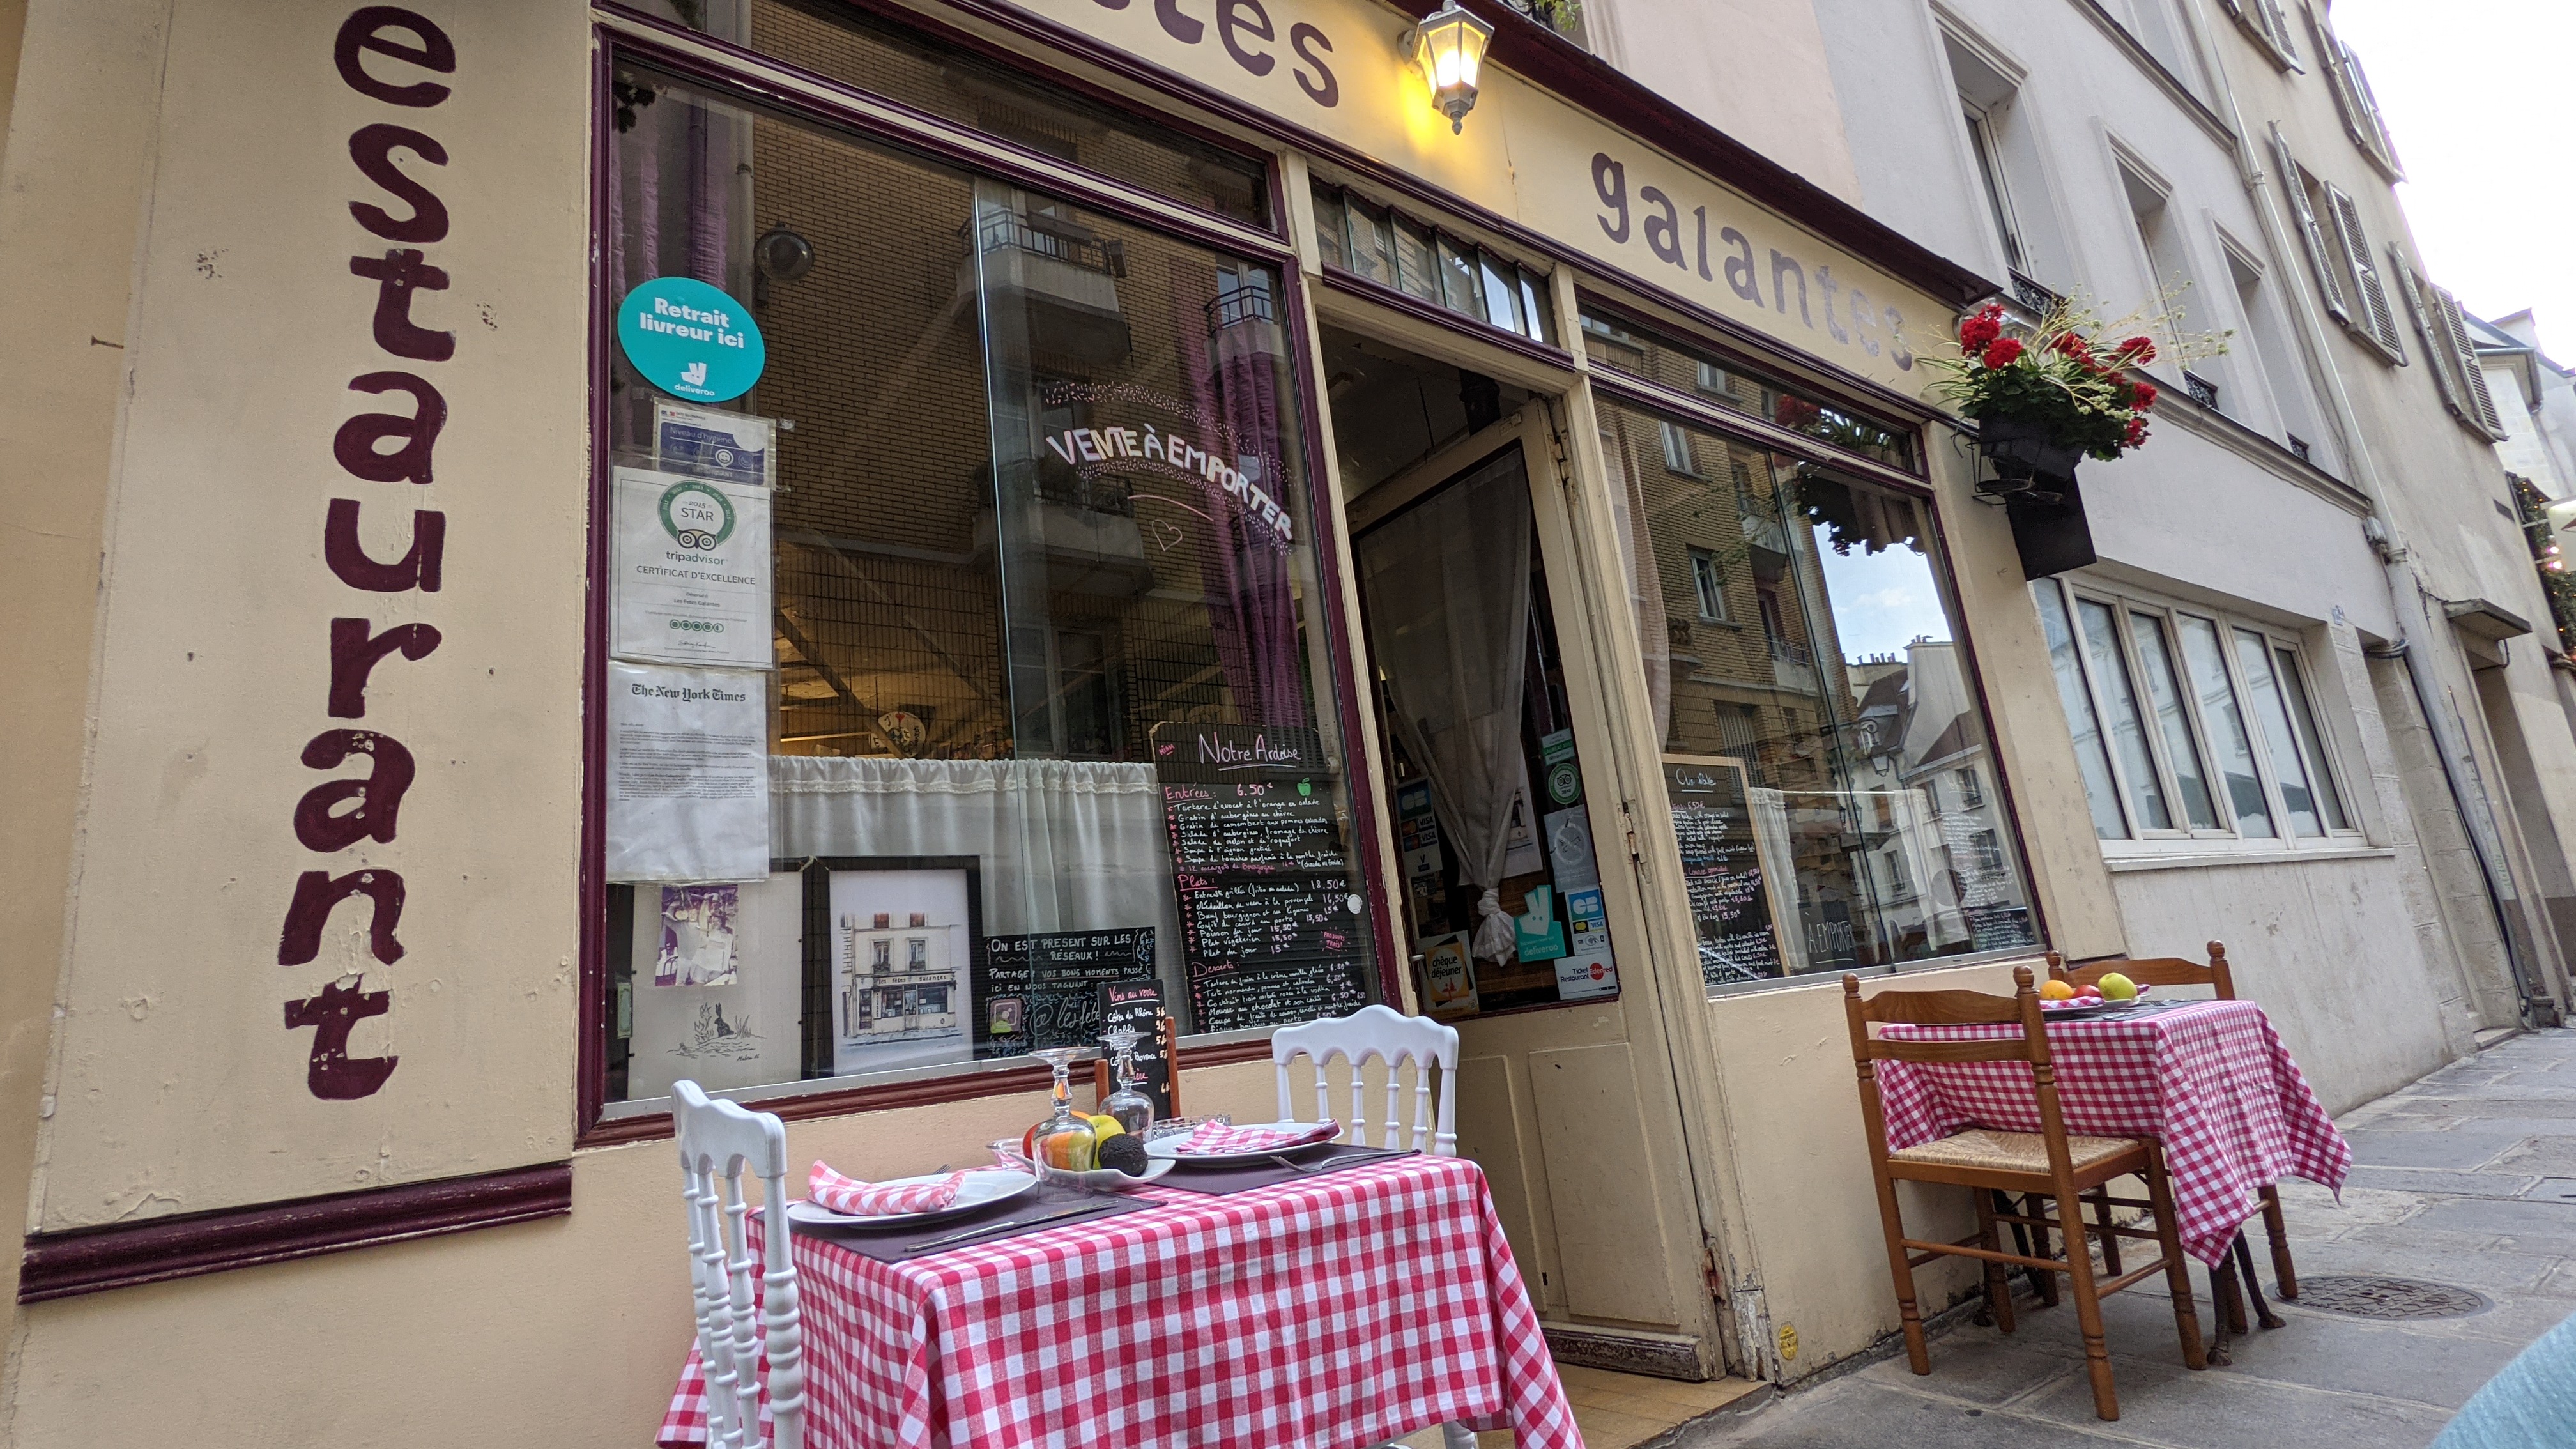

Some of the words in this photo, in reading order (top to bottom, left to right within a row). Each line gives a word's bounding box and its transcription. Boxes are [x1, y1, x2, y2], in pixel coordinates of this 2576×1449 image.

[1591, 152, 1912, 371] galantes
[655, 297, 729, 328] Retrait
[640, 312, 713, 341] livreur
[717, 328, 744, 348] ici
[674, 383, 715, 396] deliveroo
[671, 427, 695, 437] Niveau
[1046, 427, 1143, 465] VENTE
[1144, 423, 1165, 460] À
[1168, 434, 1292, 540] EMPORTER
[681, 508, 714, 521] STAR
[666, 551, 725, 565] tripadvisor
[636, 565, 689, 578] CERTIFICAT
[691, 571, 756, 585] D'EXCELLENCE
[632, 683, 654, 697] The
[656, 686, 680, 698] New
[682, 687, 710, 702] York
[712, 689, 746, 702] Times
[1199, 732, 1253, 764] Notre
[1255, 734, 1302, 762] Ardoise
[1419, 816, 1433, 826] VISA
[1421, 832, 1436, 841] VISA
[1015, 940, 1038, 951] EST
[1041, 937, 1086, 949] PRESENT
[1091, 935, 1110, 946] SUR
[1114, 934, 1131, 945] LES
[1524, 944, 1558, 956] deliveroo
[1432, 955, 1457, 967] chèque
[1042, 969, 1057, 977] VOS
[1085, 968, 1119, 976] MOMENTS
[1431, 965, 1462, 979] déjeuner
[1590, 966, 1613, 975] Edenred
[1560, 974, 1590, 983] Restaurant
[1108, 985, 1125, 1002] Vins
[1107, 1009, 1124, 1022] Côtes
[1135, 1007, 1153, 1017] Rhône
[1107, 1023, 1135, 1035] Chablis
